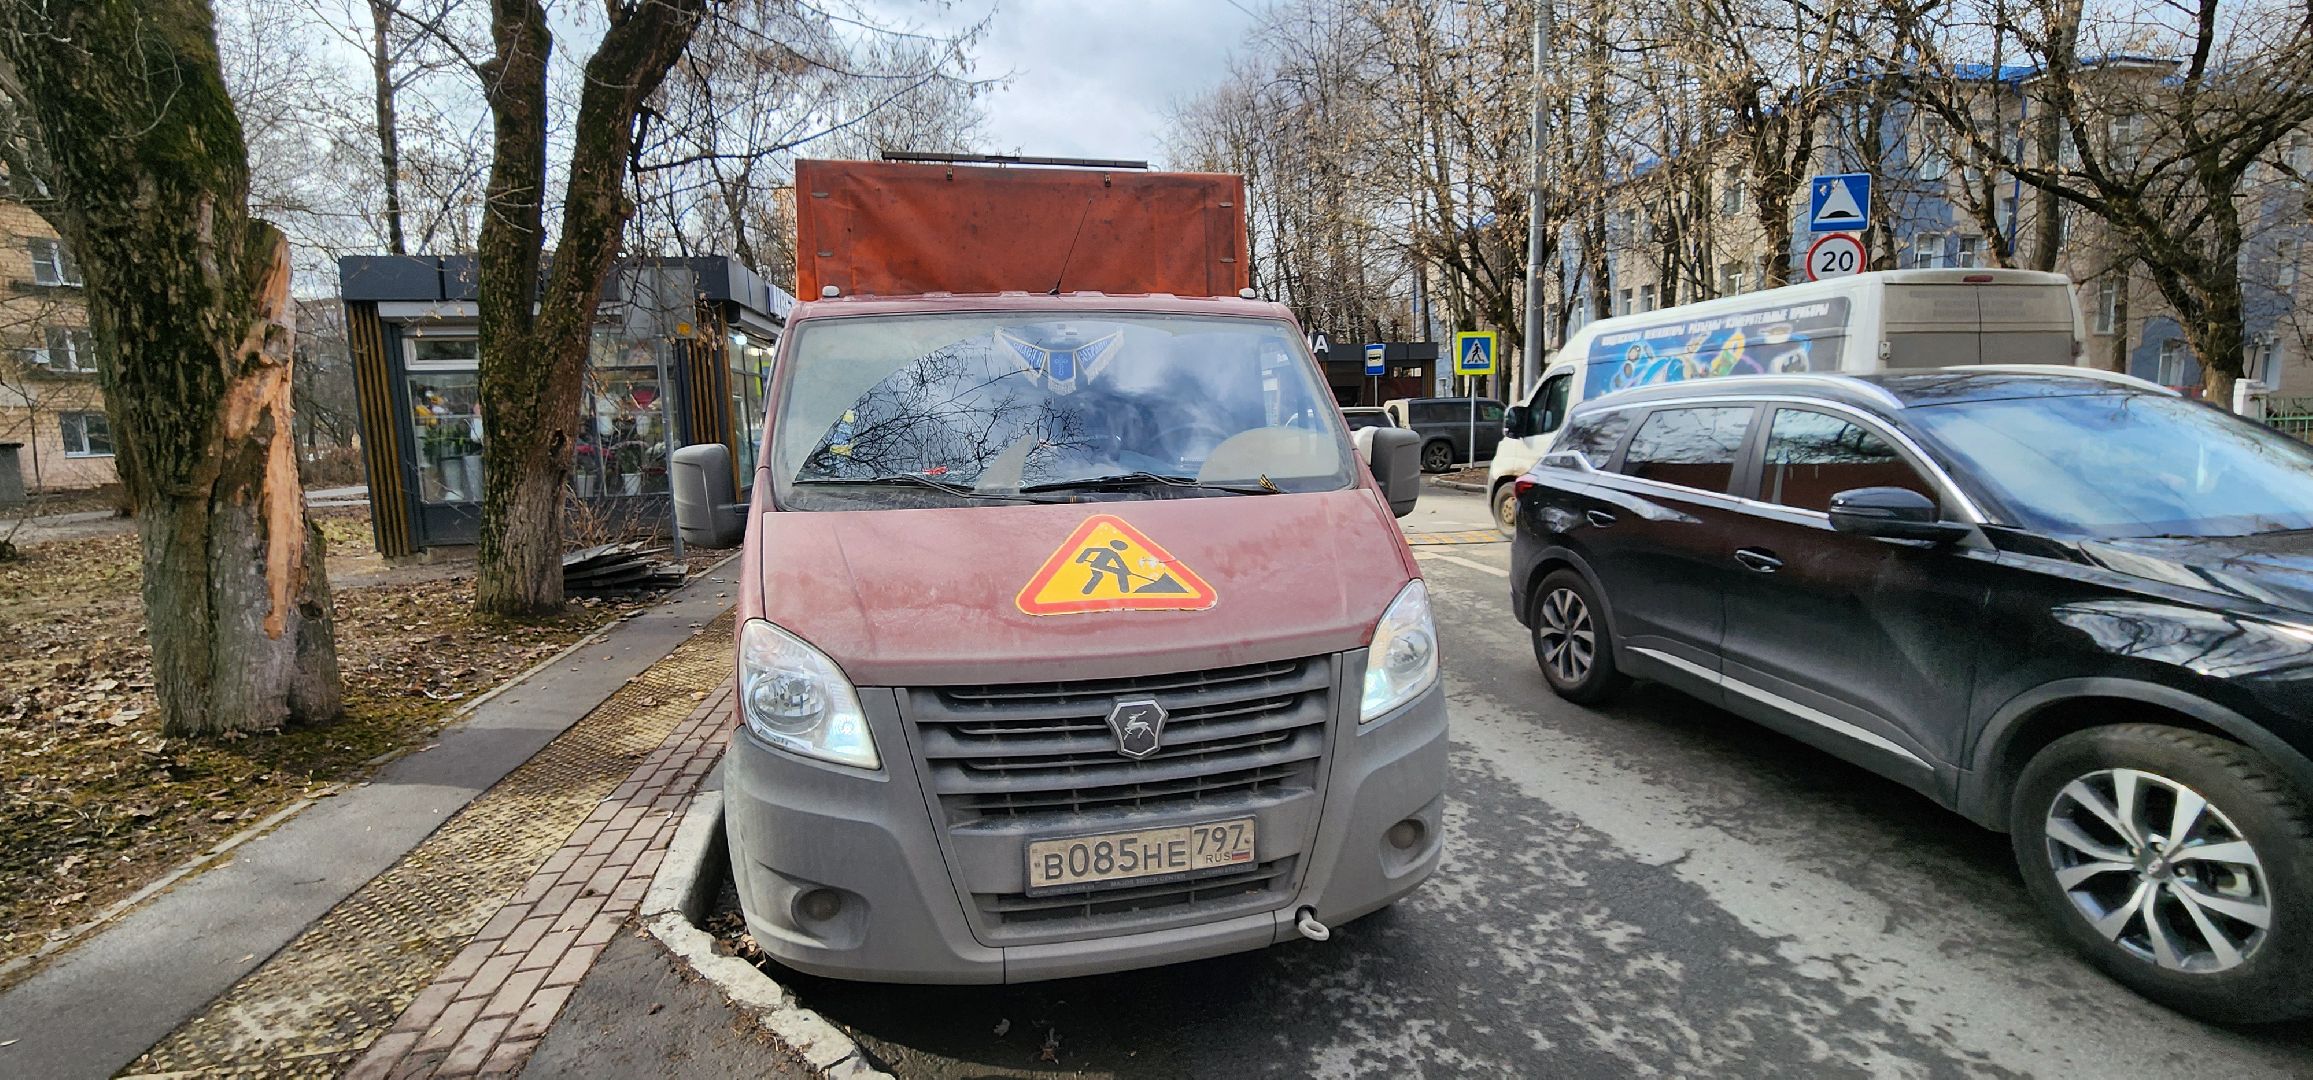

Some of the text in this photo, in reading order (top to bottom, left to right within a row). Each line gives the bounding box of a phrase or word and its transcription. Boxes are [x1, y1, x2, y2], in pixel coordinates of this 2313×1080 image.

[1821, 250, 1854, 272] 20
[1193, 824, 1246, 855] 797
[1205, 851, 1231, 864] RUS
